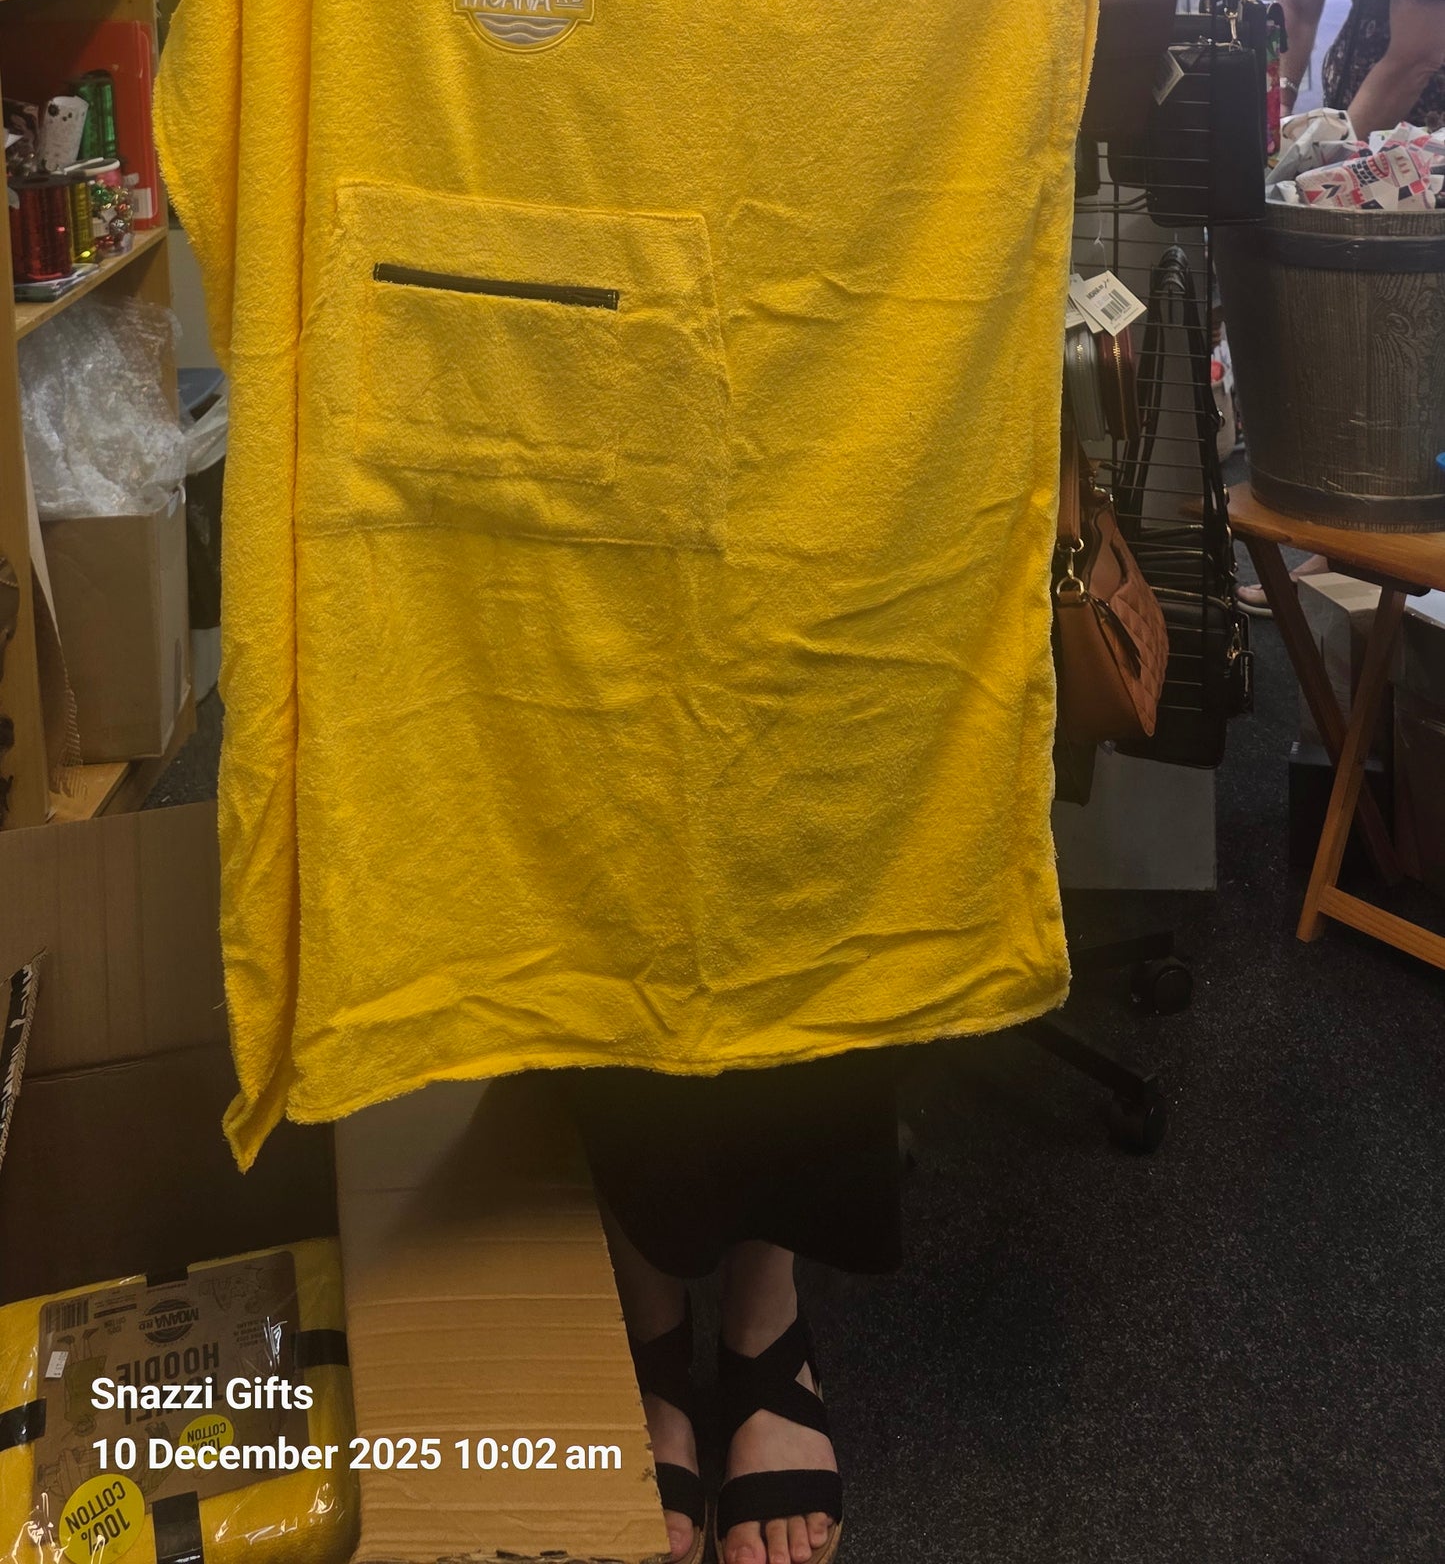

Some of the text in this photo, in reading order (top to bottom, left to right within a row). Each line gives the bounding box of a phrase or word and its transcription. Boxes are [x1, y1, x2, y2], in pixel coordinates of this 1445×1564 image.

[139, 1307, 199, 1330] MOANA RD
[116, 1341, 219, 1388] HOODIE
[187, 1422, 226, 1443] COTTON
[65, 1481, 126, 1534] COTTON
[81, 1508, 130, 1556] 100%
